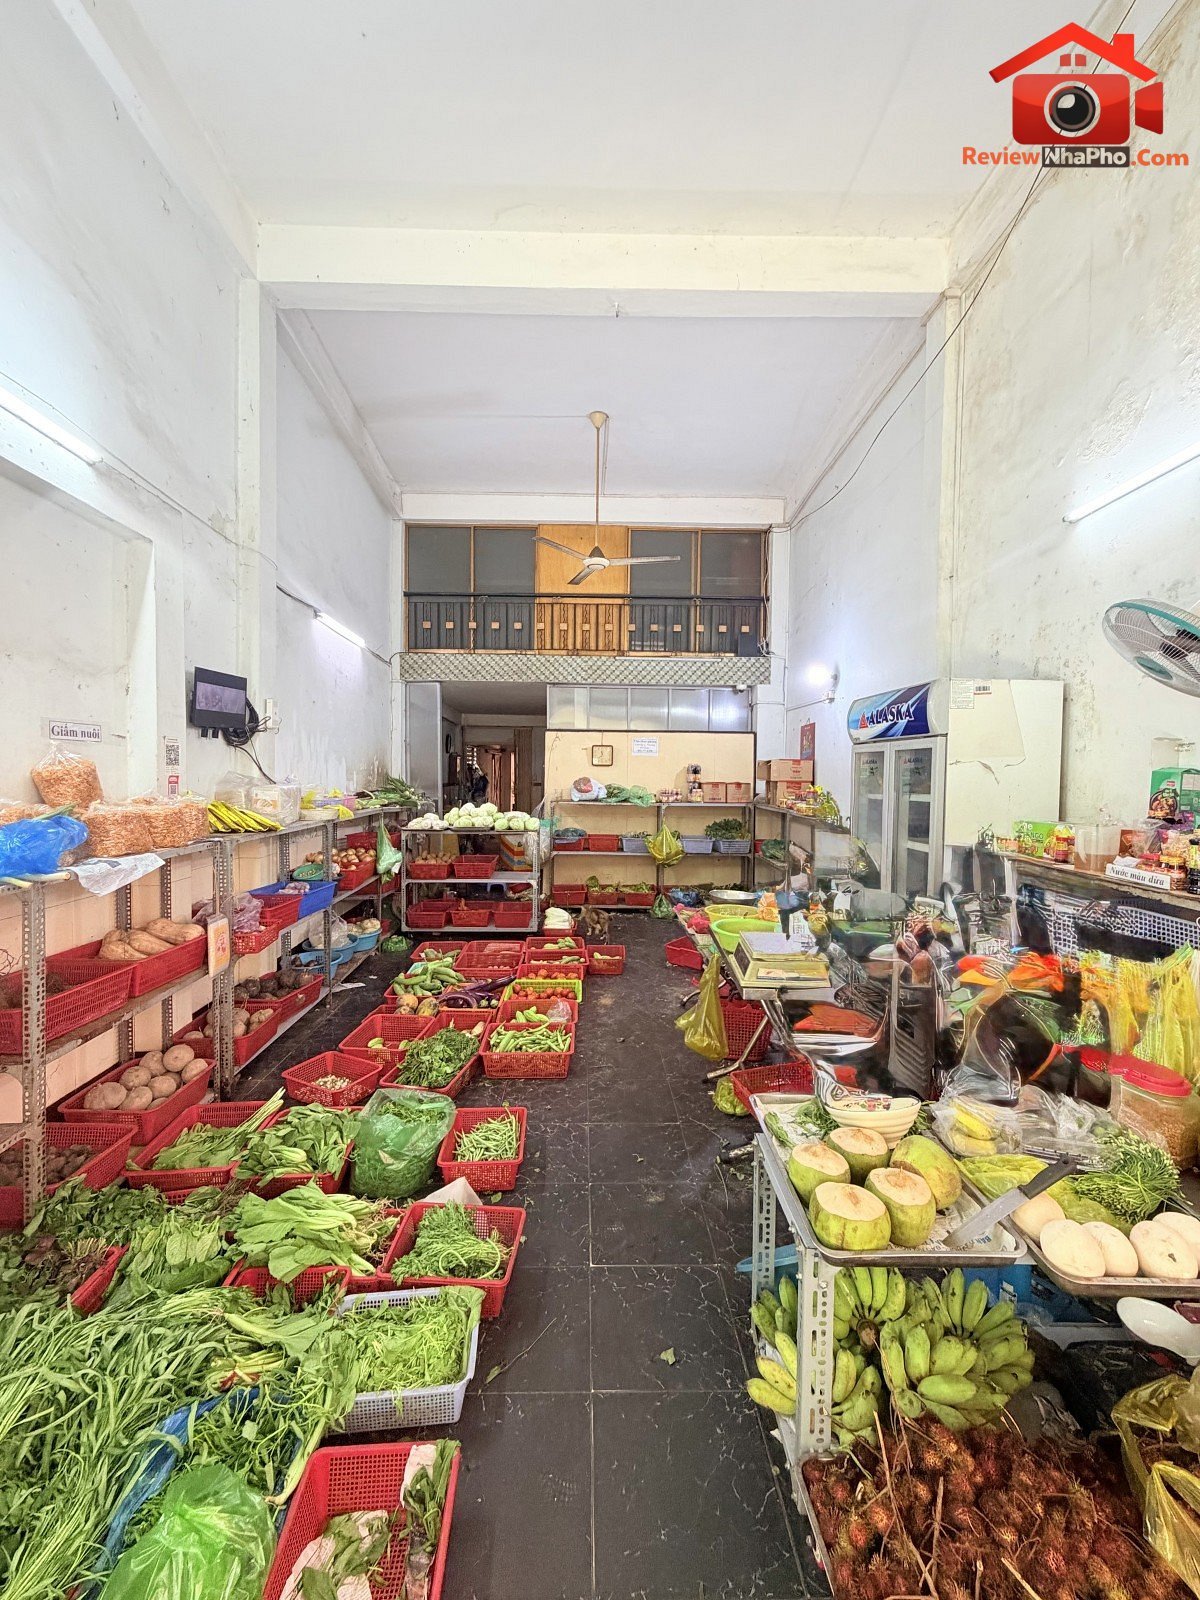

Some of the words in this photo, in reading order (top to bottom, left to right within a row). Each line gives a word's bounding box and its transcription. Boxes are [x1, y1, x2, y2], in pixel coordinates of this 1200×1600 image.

[867, 702, 914, 726] ALASKA
[51, 723, 78, 738] Giấm
[80, 728, 100, 739] nuôi
[1130, 872, 1146, 882] màu
